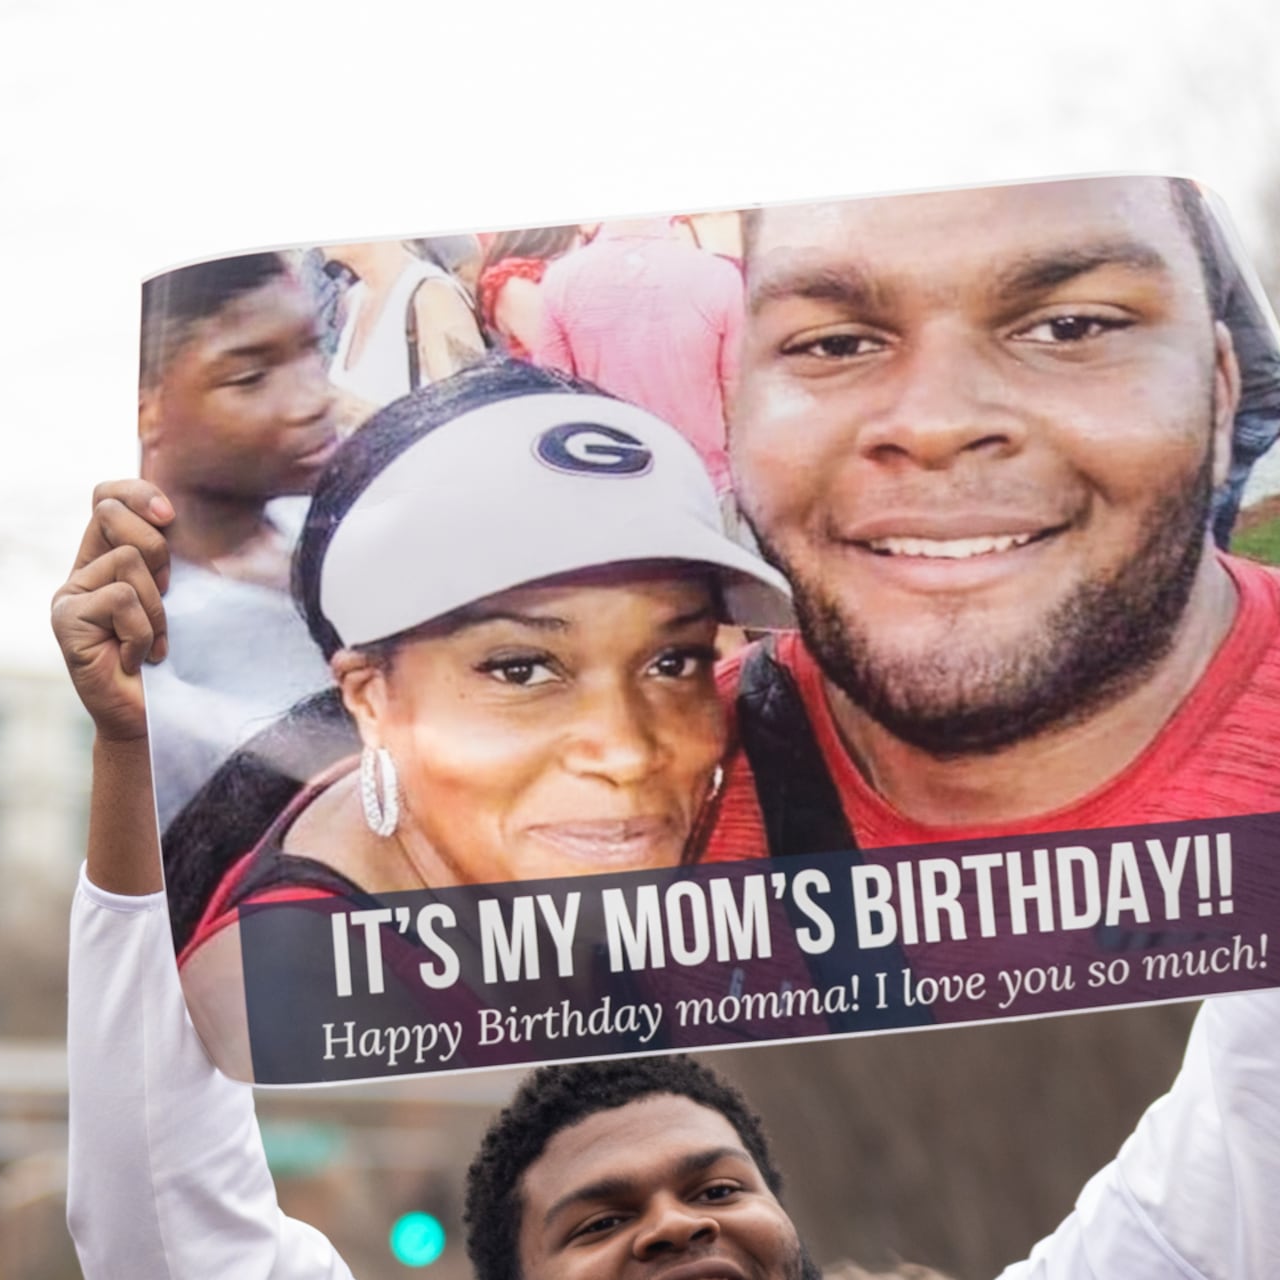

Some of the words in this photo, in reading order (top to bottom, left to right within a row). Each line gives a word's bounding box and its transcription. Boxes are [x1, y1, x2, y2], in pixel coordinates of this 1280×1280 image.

[533, 421, 654, 479] G
[331, 903, 460, 997] IT'S
[478, 891, 582, 984] MY
[601, 869, 835, 973] MOM'S
[851, 832, 1234, 949] BIRTHDAY!!
[322, 1021, 462, 1066] Happy
[478, 996, 662, 1045] Birthday
[675, 974, 859, 1027] momma!
[875, 972, 888, 1009] I
[902, 968, 986, 1006] love
[998, 965, 1075, 1009] you
[1088, 959, 1130, 987] so
[1142, 933, 1268, 981] much!
